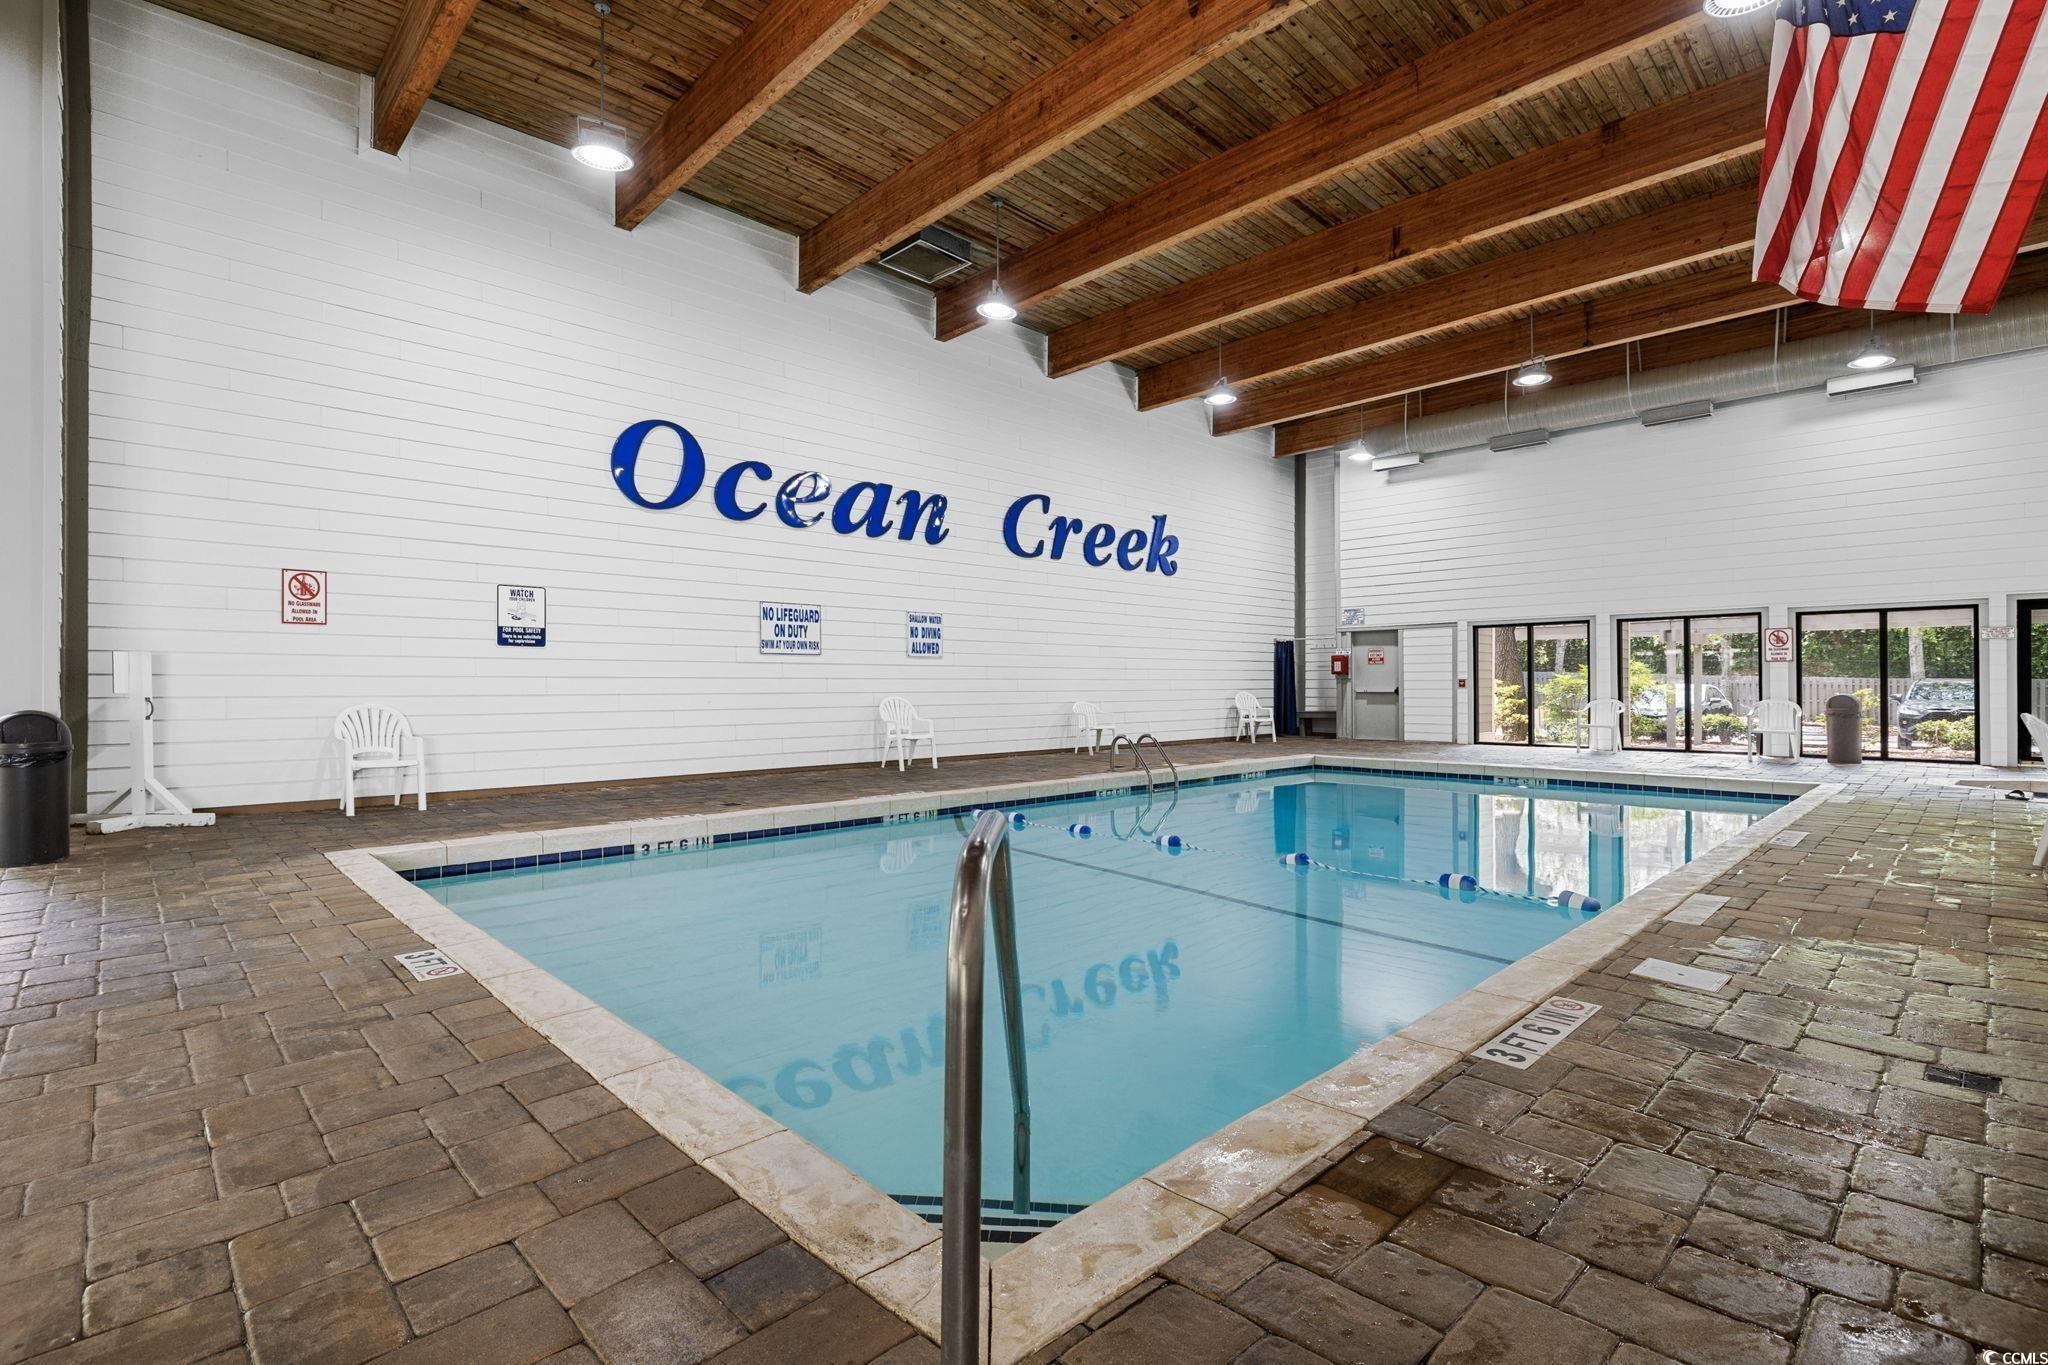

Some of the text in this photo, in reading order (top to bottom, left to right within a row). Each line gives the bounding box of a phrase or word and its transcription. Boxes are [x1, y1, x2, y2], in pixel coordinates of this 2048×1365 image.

[611, 419, 1180, 576] Ocean Creek
[510, 589, 534, 598] WATCH
[763, 607, 820, 623] NO LIFEGUARD
[909, 614, 942, 625] SHALLOW WATER
[774, 623, 808, 638] ON DUTY
[910, 626, 941, 640] NO DIVING
[761, 640, 820, 650] SWIM AT YOUR OWN RISK
[911, 642, 940, 655] ALLOWED
[657, 840, 674, 850] FT
[696, 836, 710, 846] IN
[1534, 1009, 1580, 1027] IN
[1521, 1023, 1561, 1036] 6
[1499, 1032, 1548, 1053] FT
[1486, 1048, 1527, 1063] 3
